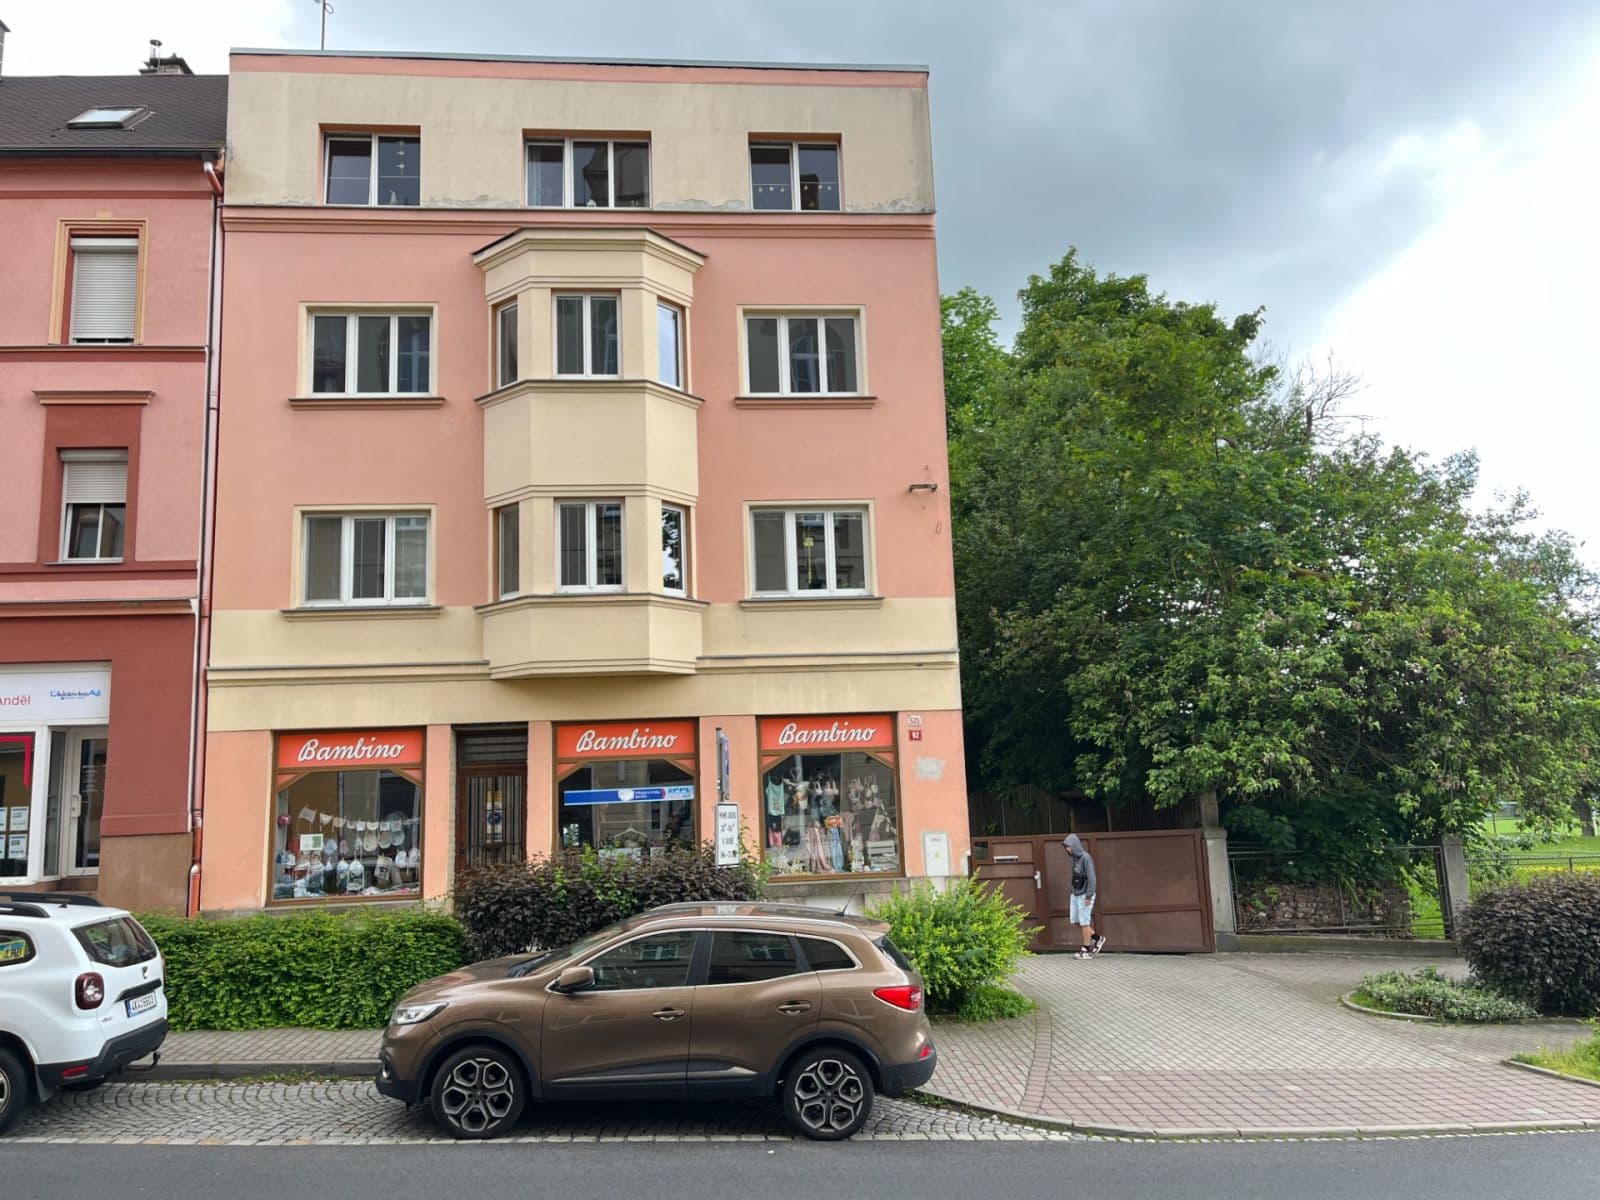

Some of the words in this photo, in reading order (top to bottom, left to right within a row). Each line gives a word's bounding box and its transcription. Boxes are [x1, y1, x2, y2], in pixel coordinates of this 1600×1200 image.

[576, 728, 678, 752] Bambino
[779, 722, 876, 744] Bambino
[298, 737, 405, 761] Bambino
